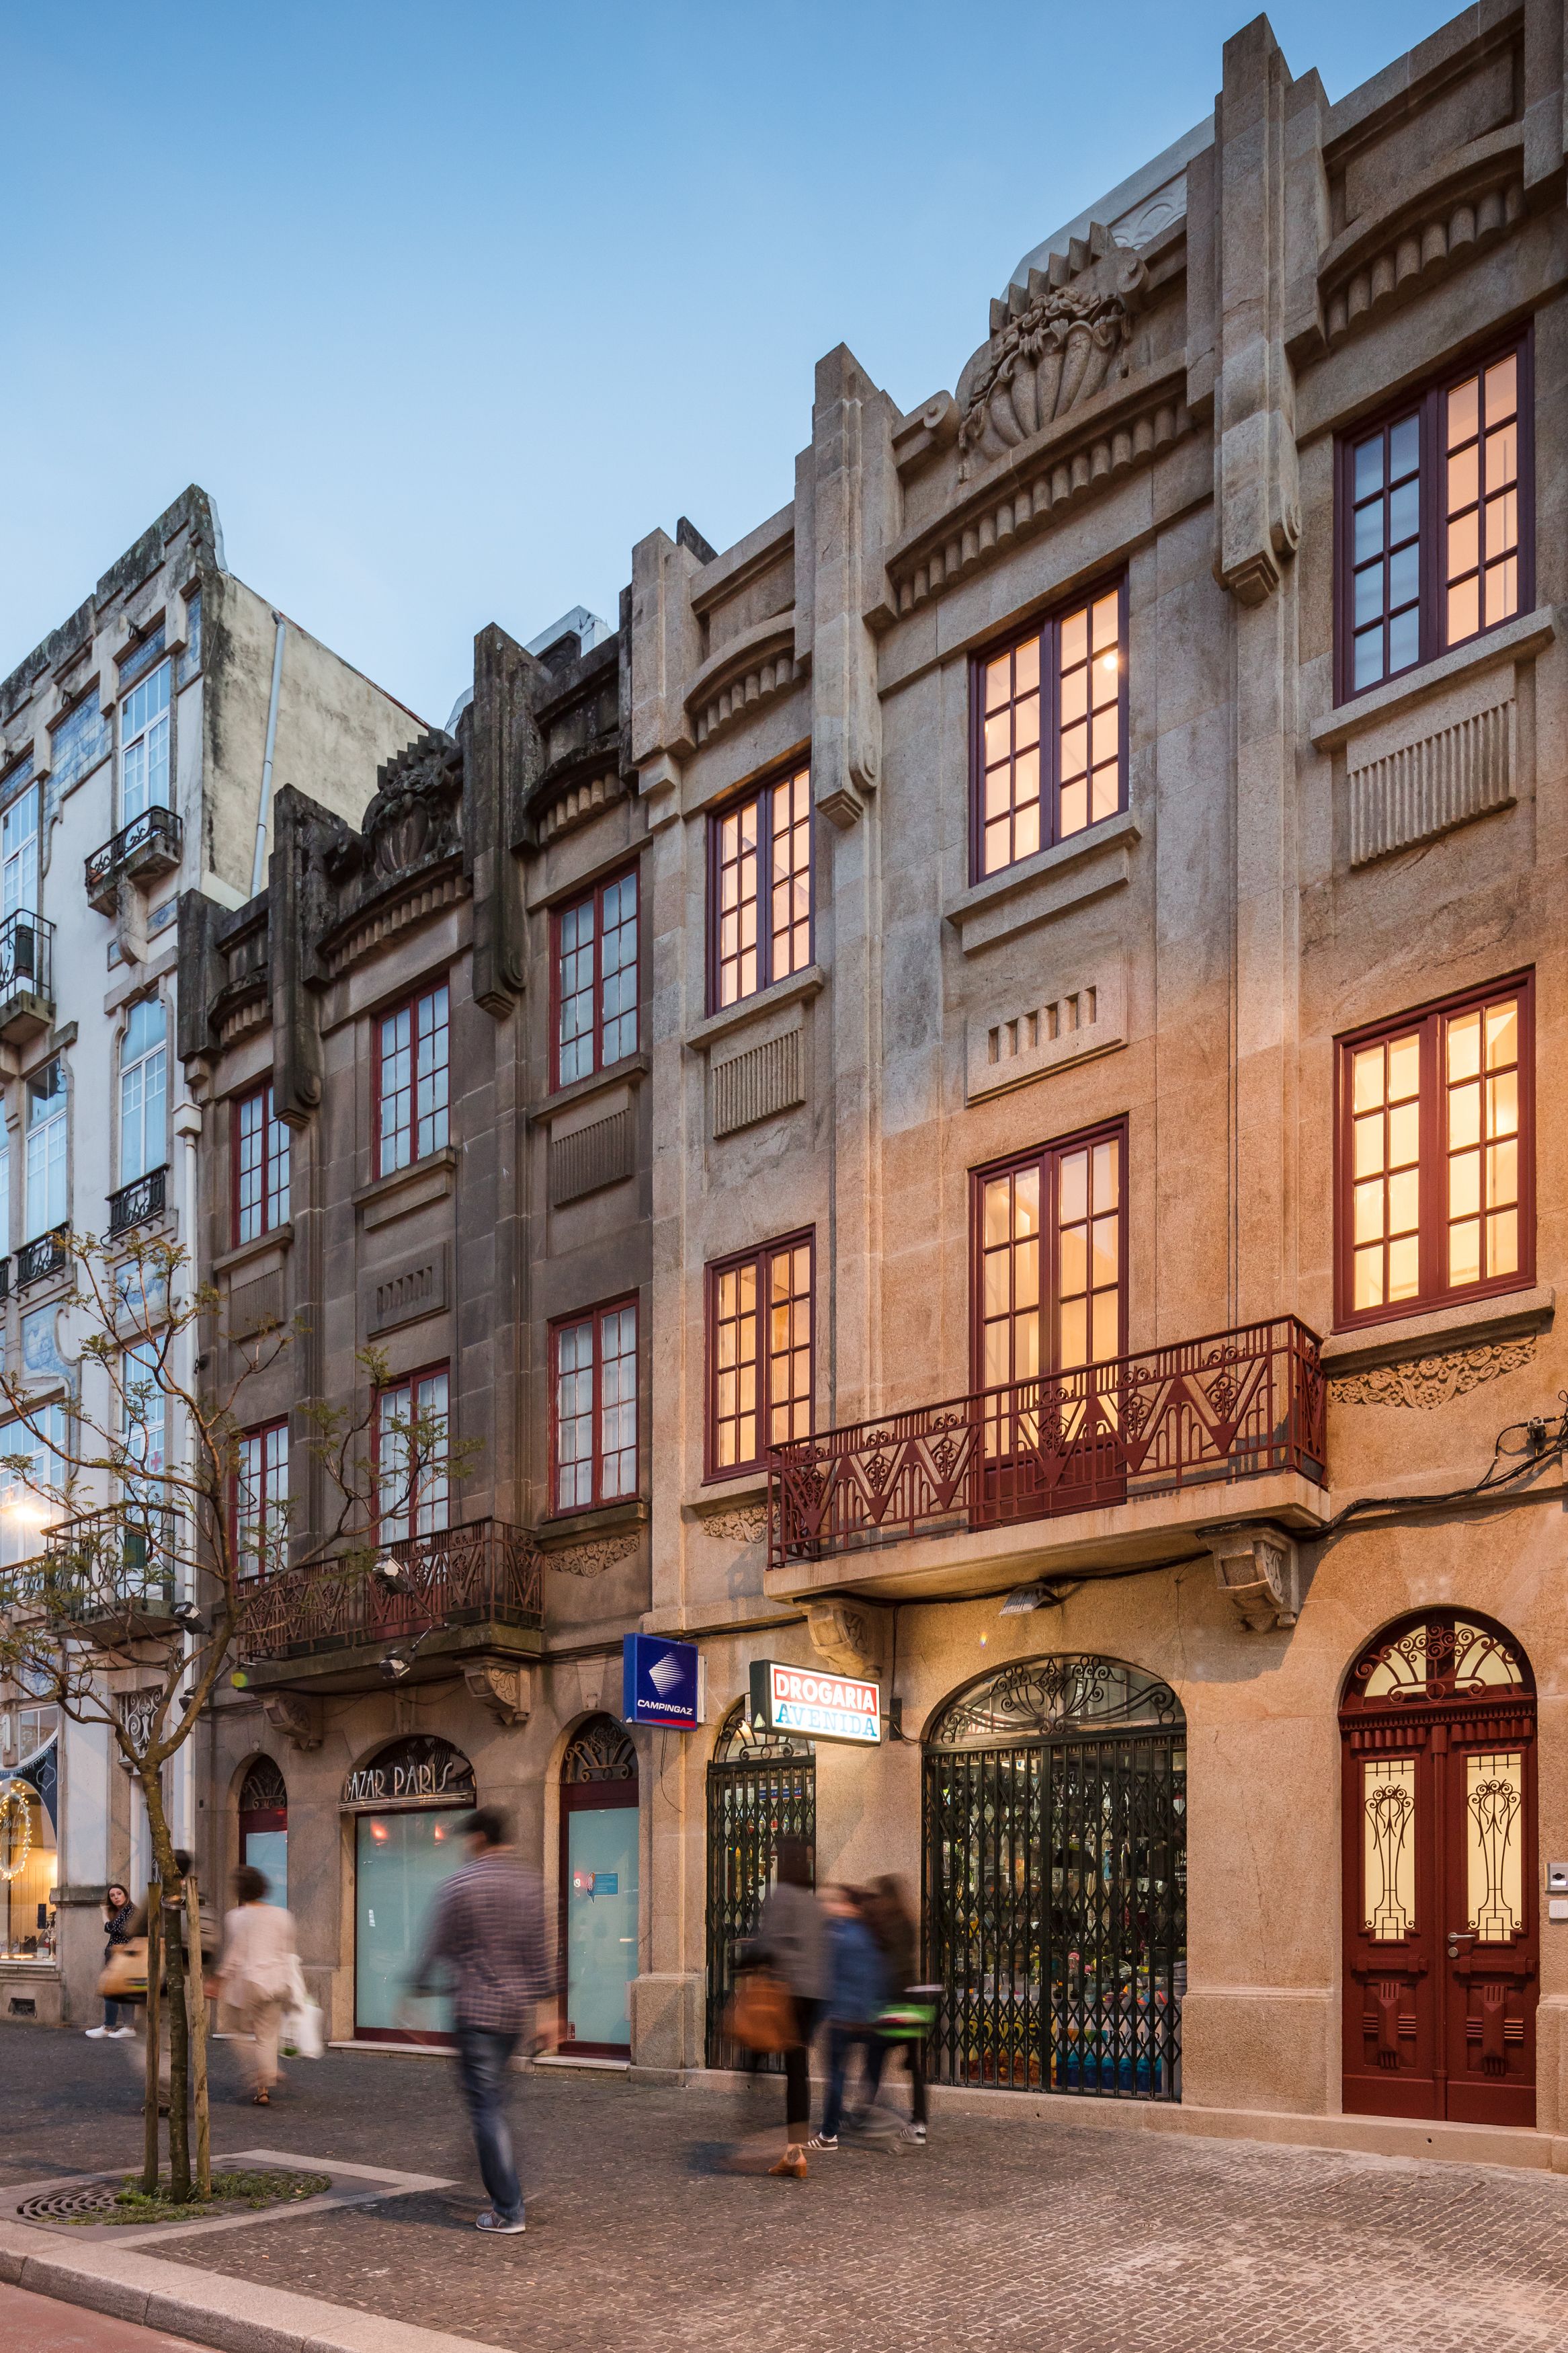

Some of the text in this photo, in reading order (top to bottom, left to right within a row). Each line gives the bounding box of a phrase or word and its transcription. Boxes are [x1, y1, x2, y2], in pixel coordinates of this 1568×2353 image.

[637, 1699, 693, 1715] CAMPINGAZ
[775, 1673, 876, 1712] DROGARIA
[775, 1703, 878, 1737] AVENIDA
[344, 1762, 452, 1801] BAZAR PARIS
